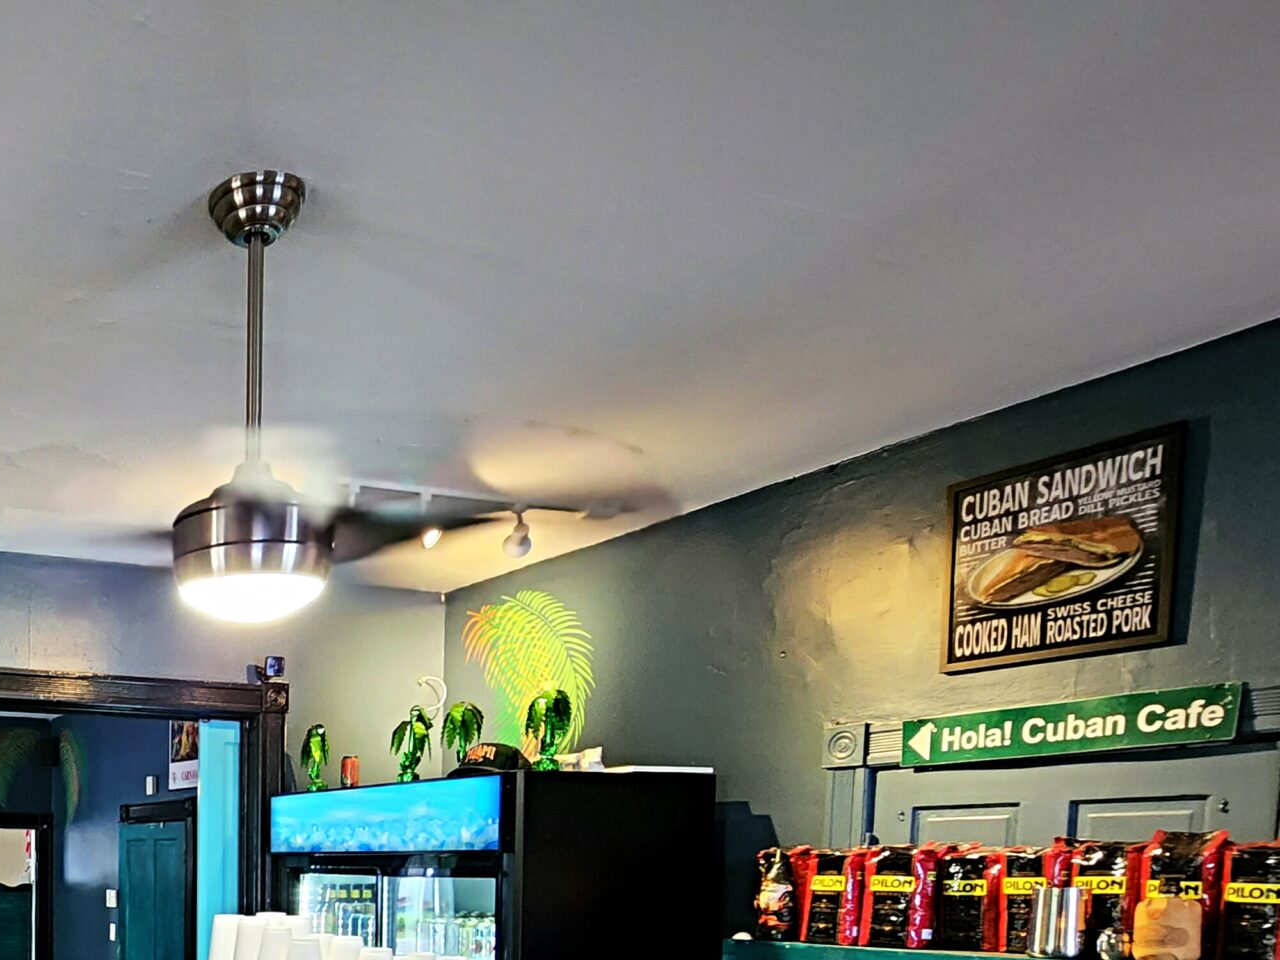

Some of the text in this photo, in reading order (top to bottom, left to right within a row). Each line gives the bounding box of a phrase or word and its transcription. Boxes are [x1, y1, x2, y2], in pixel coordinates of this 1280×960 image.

[961, 444, 1163, 522] CUBAN SANDWICH
[1077, 479, 1161, 505] YELLOW MUSTARD
[1078, 488, 1161, 516] DILL PICKLES
[960, 501, 1074, 542] CUBAN BREAD
[959, 536, 1007, 557] BUTTER
[1047, 590, 1153, 620] SWISS CHEESE
[954, 612, 1042, 658] COOKED HAM
[1046, 605, 1152, 644] ROASTED PORK
[940, 698, 1226, 752] Hola! Cuban Cafe
[812, 877, 843, 888] PILON
[872, 877, 914, 889] PILON
[1076, 879, 1123, 890] PILON
[1227, 887, 1280, 900] PILON
